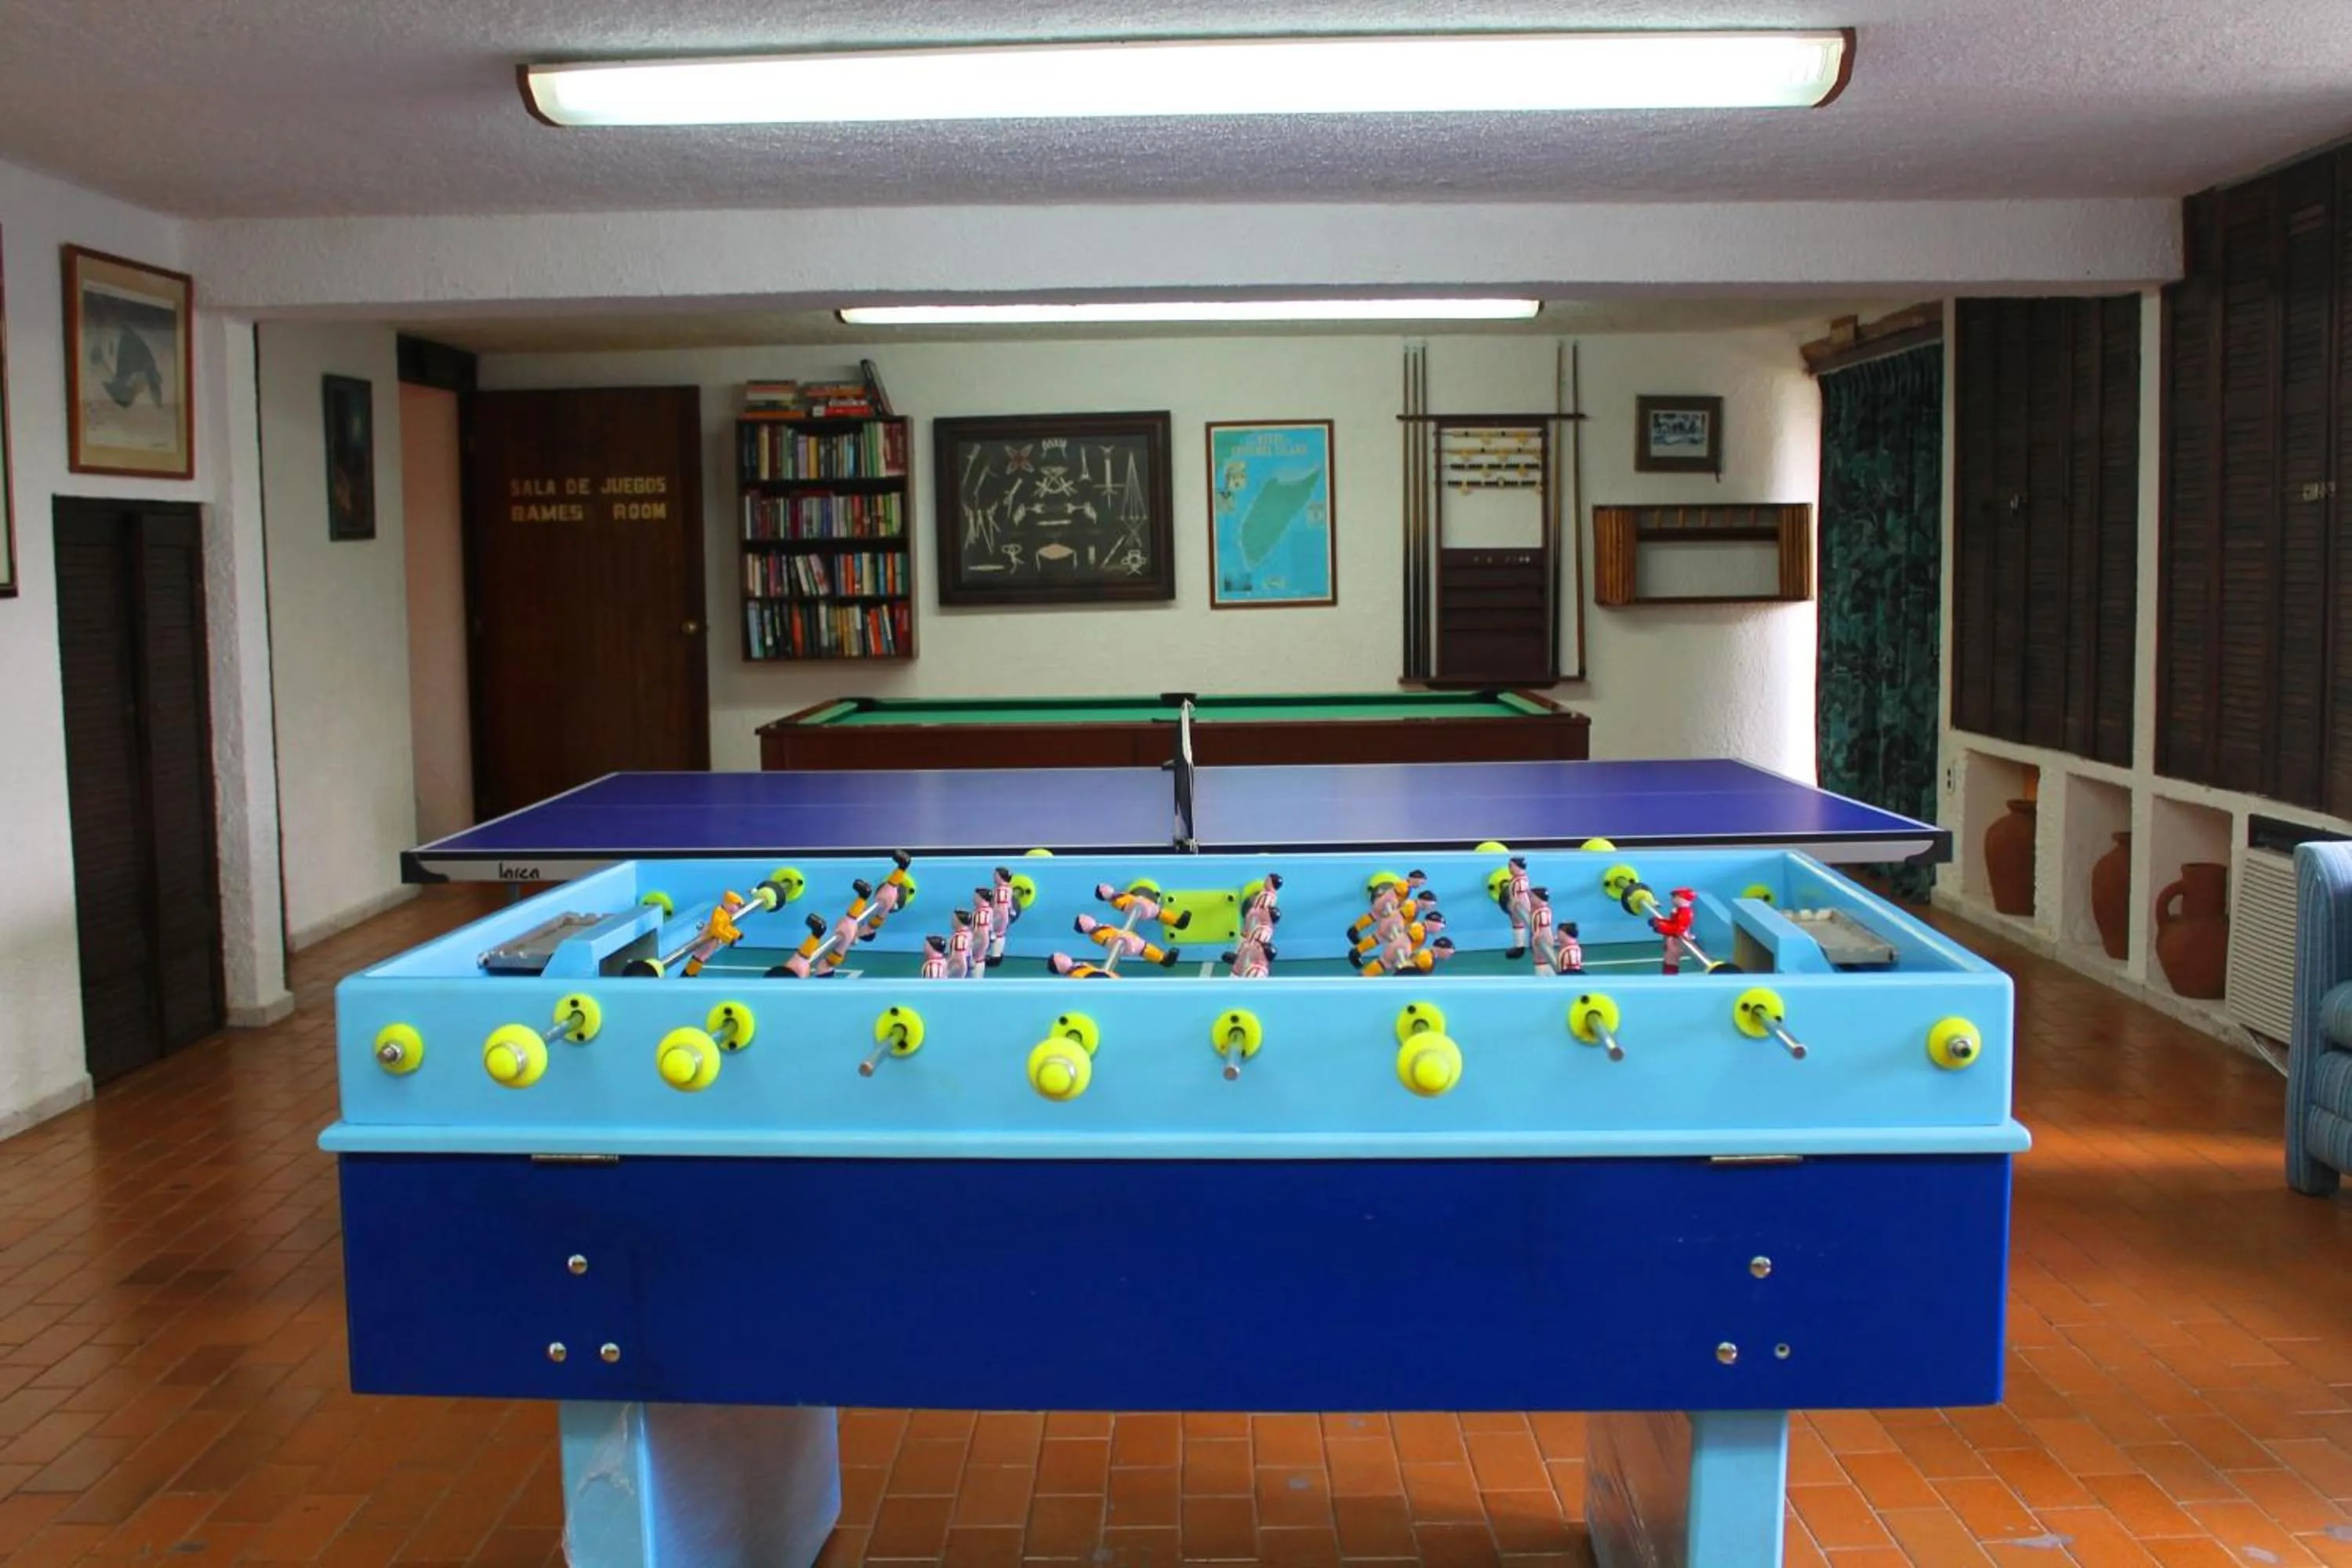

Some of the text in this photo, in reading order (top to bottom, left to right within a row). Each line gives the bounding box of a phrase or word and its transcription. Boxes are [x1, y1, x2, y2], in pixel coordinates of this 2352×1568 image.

[510, 476, 666, 496] SALA DE JUEGOS
[511, 502, 666, 521] GAMES ROOM
